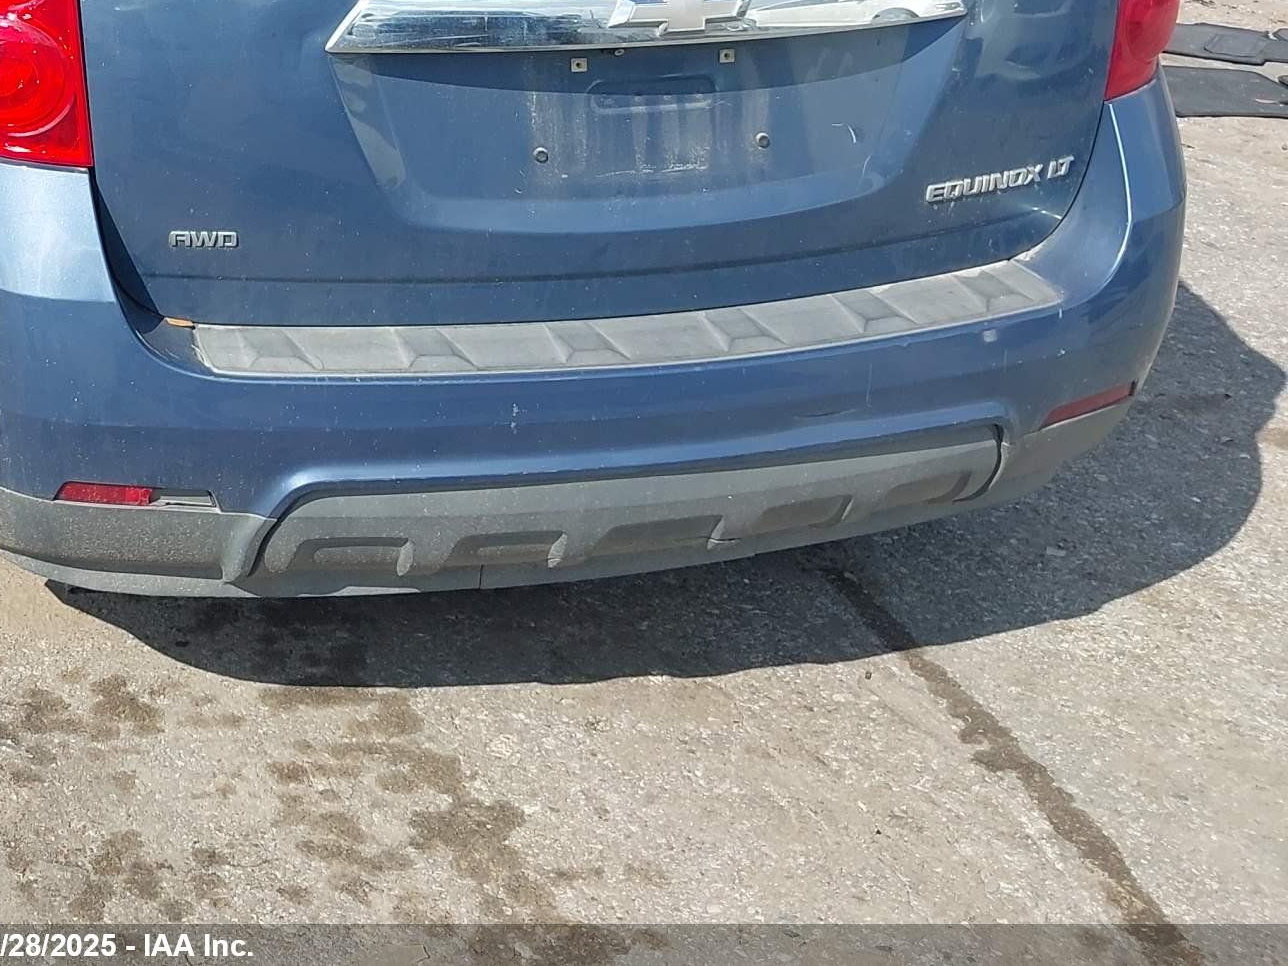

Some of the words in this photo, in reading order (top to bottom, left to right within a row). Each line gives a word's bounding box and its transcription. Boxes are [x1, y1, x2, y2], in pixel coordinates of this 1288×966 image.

[926, 164, 1043, 202] EQUINOX
[1047, 155, 1074, 179] LT
[168, 230, 238, 248] AWD
